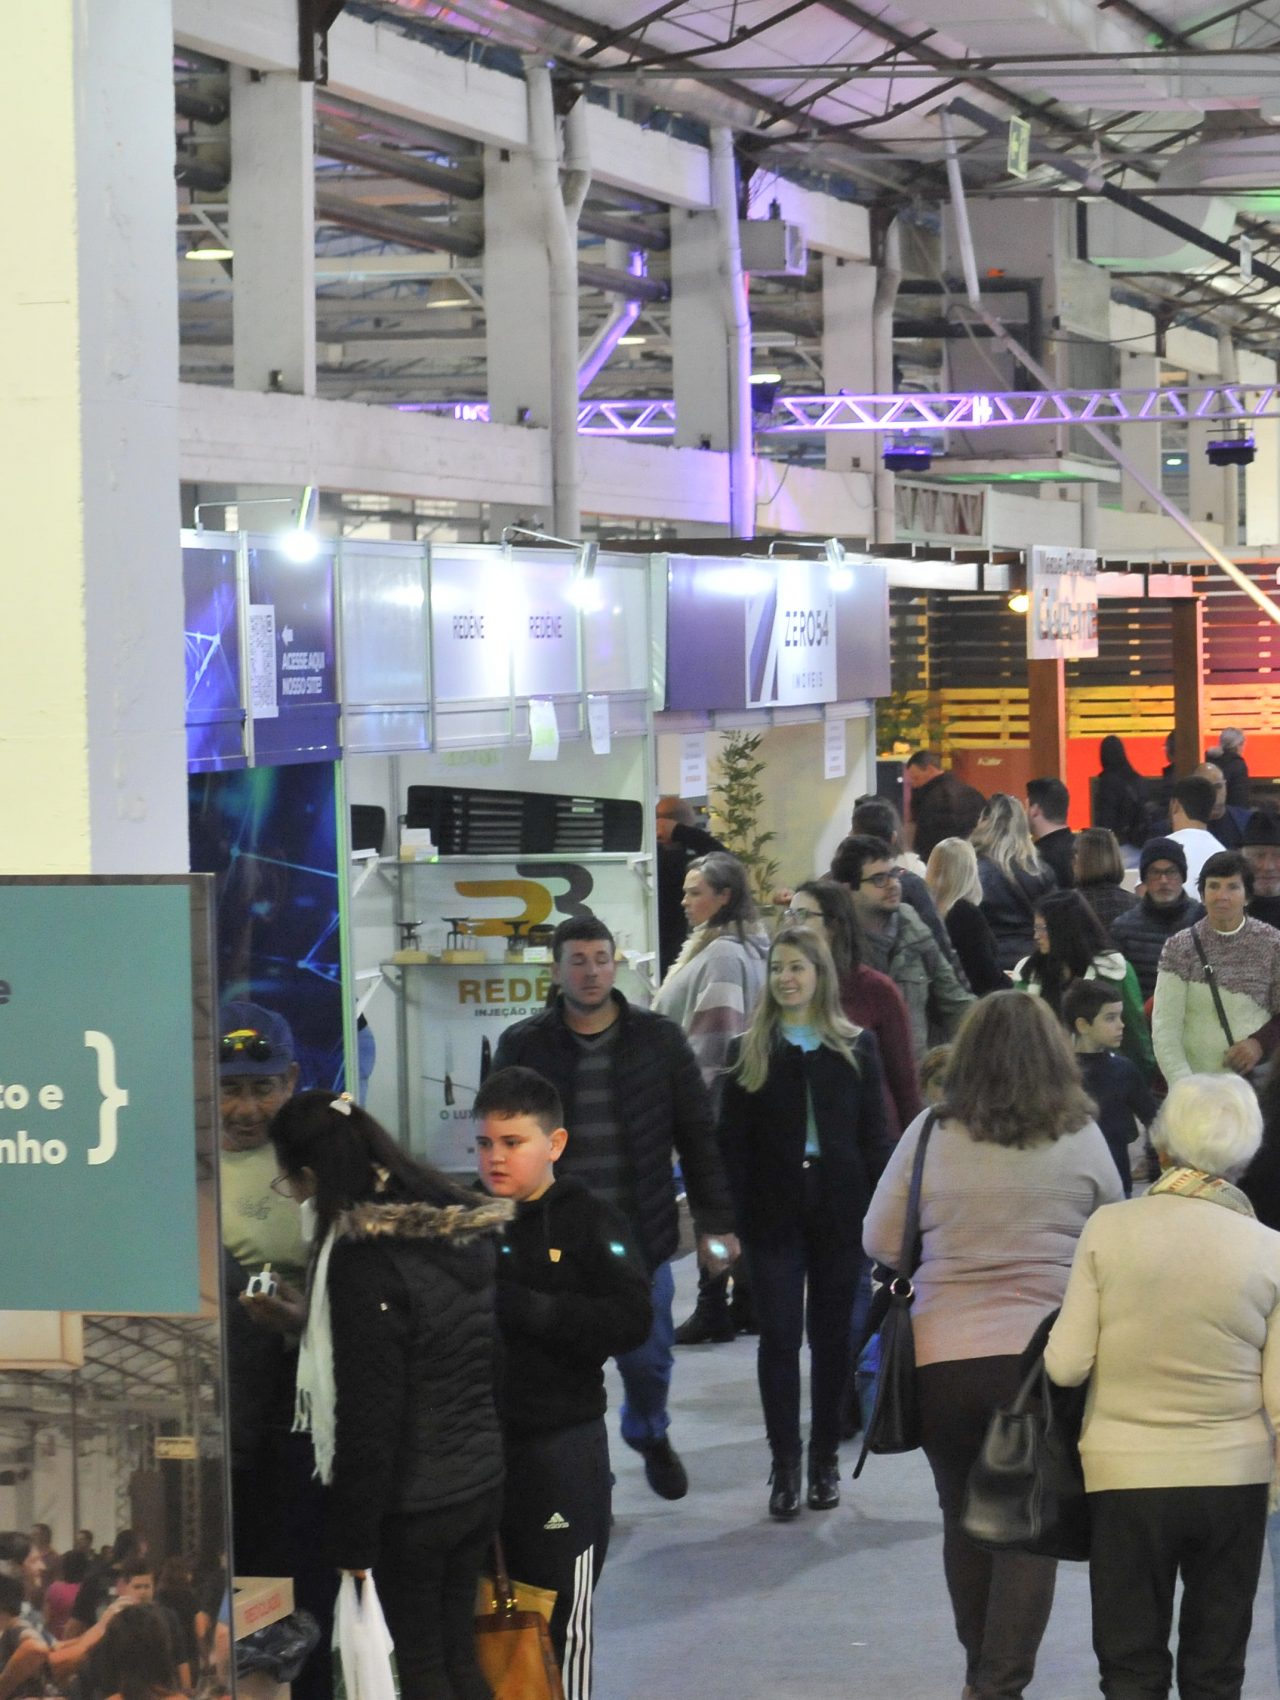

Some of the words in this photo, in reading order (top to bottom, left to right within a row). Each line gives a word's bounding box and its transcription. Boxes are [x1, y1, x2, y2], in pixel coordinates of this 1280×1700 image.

[785, 610, 829, 647] ZERO54
[458, 968, 551, 1004] REDÊ
[0, 1084, 30, 1110] o
[38, 1084, 64, 1110] e
